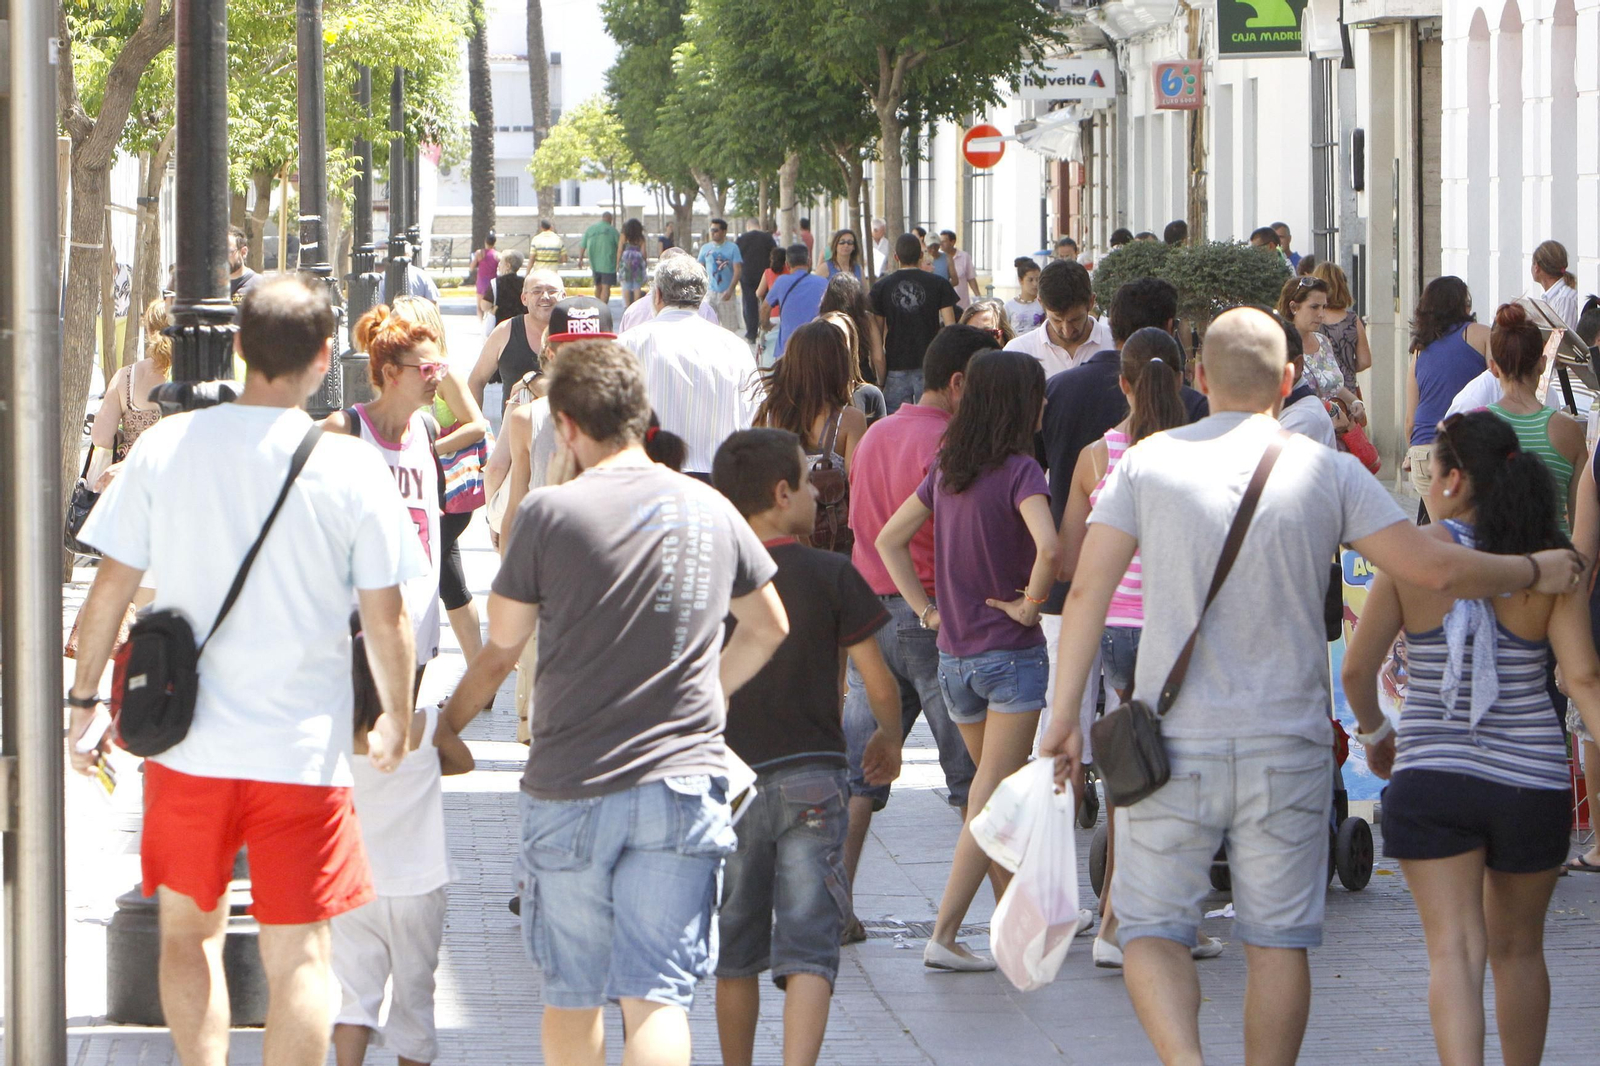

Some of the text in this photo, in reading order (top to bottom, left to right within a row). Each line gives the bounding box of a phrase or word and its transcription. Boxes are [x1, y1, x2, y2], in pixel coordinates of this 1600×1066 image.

[1231, 32, 1257, 42] CAJA
[568, 318, 600, 335] FRESH
[699, 532, 714, 561] FOR
[694, 566, 711, 610] BUILT
